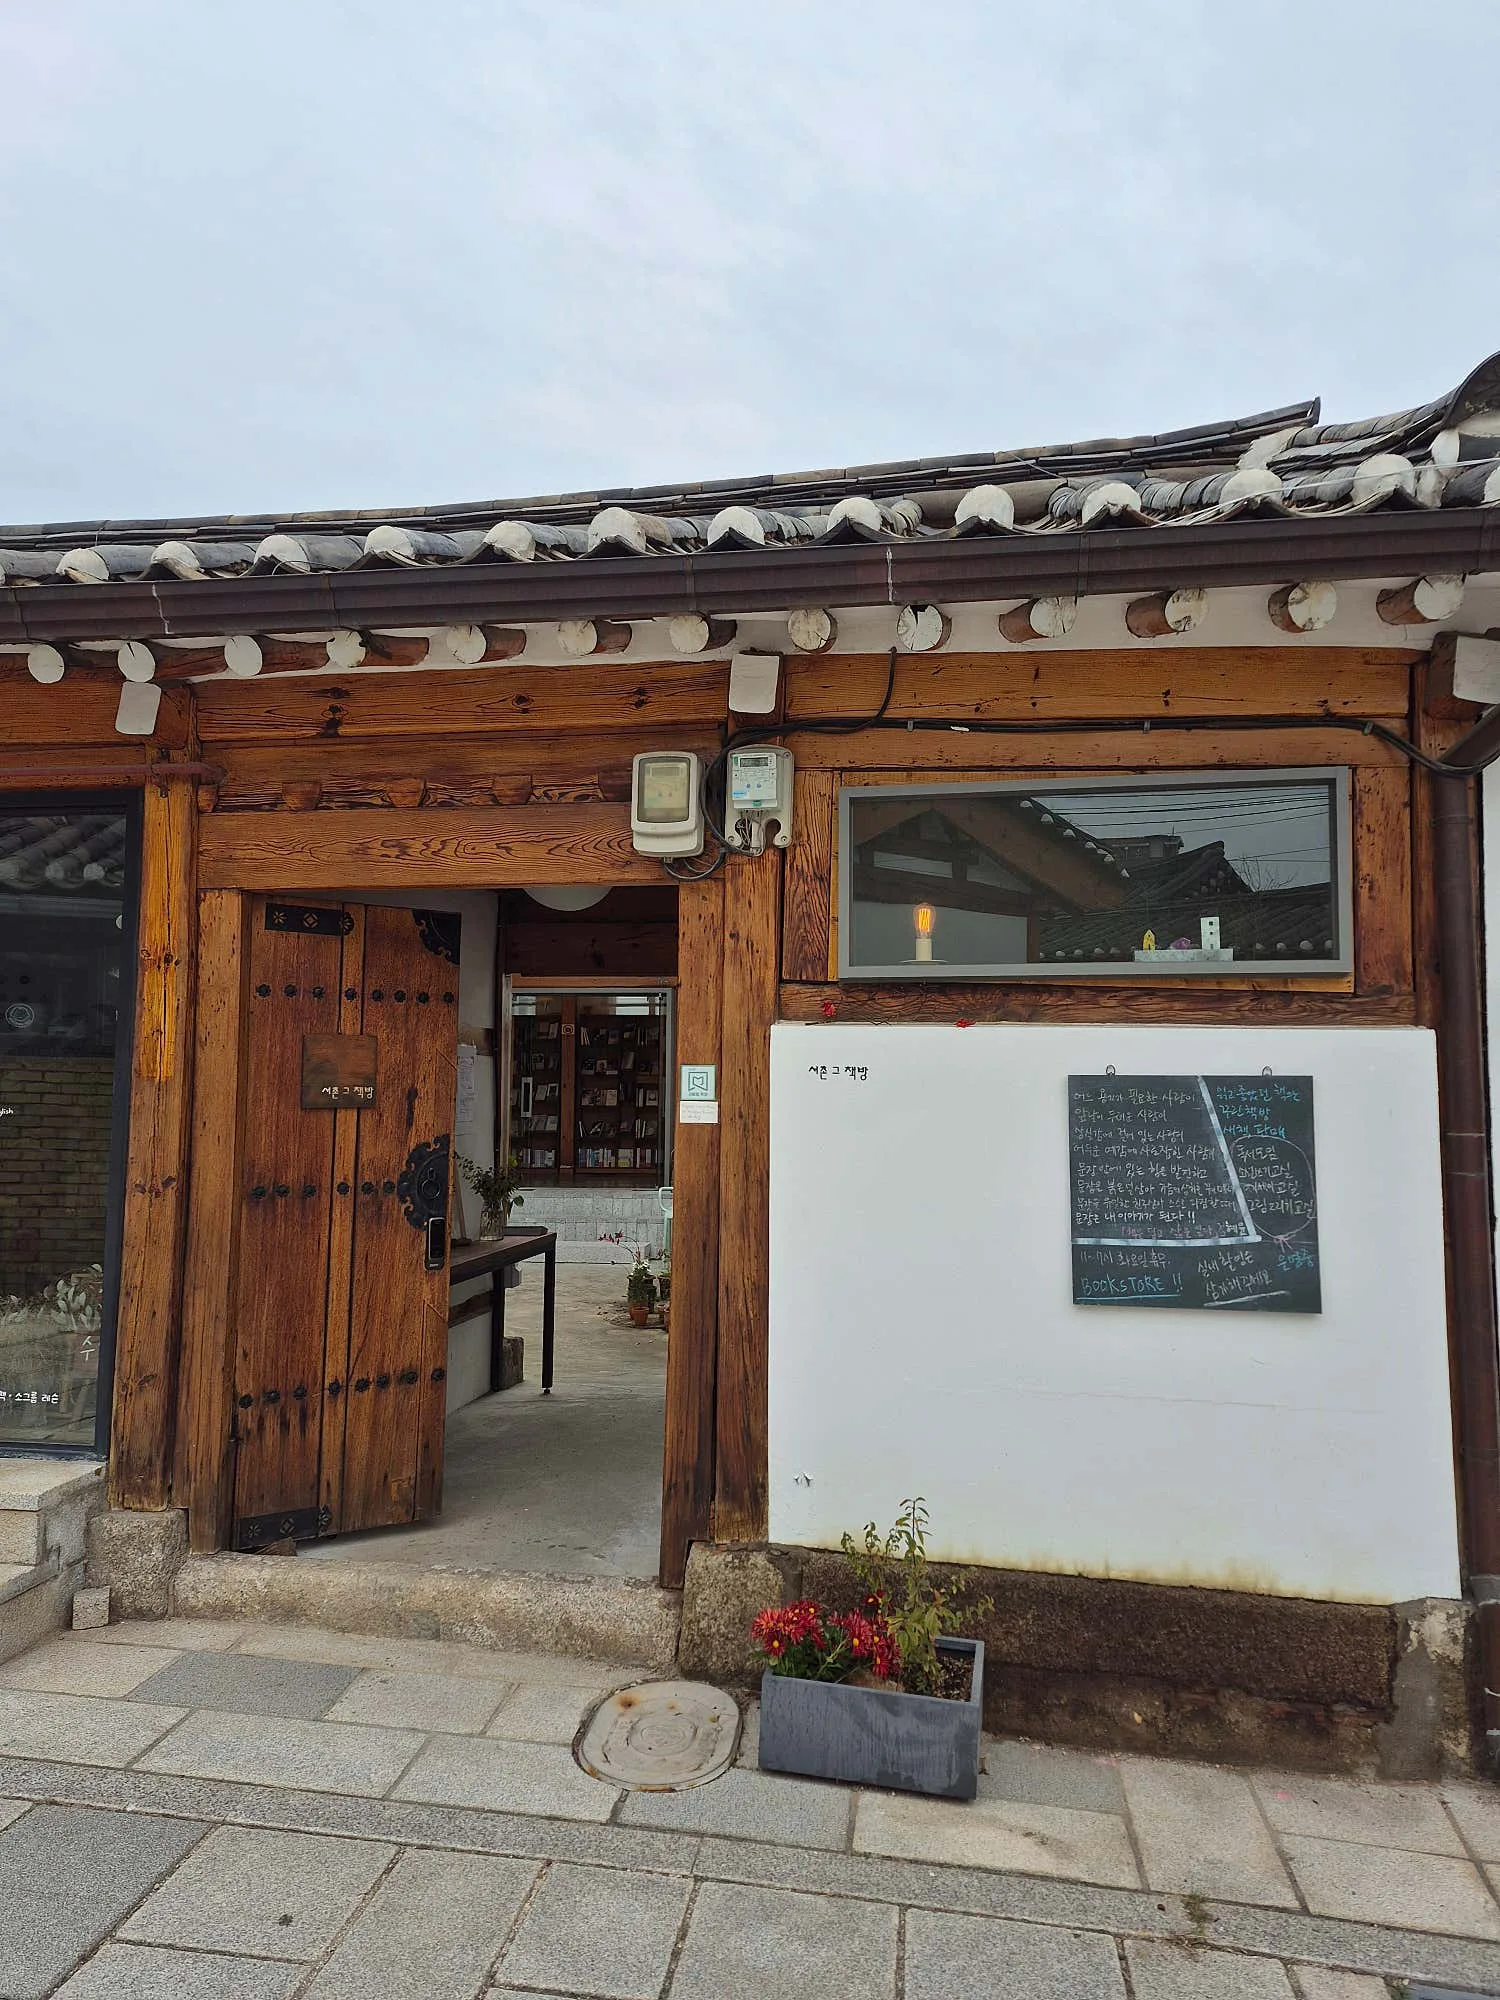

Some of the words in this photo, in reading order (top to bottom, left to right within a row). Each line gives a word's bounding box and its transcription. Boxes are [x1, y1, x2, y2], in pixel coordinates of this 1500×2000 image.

[809, 1065, 828, 1080] 서촌
[831, 1066, 841, 1075] 그
[844, 1065, 869, 1081] 책방
[321, 1086, 339, 1100] 서촌
[342, 1086, 350, 1095] 그
[353, 1086, 375, 1099] 책방
[1162, 1088, 1195, 1108] 사람이
[1137, 1108, 1167, 1123] 사람이
[1157, 1128, 1184, 1143] 사람이
[1104, 1210, 1116, 1223] 내
[41, 1392, 60, 1405] 레슨
